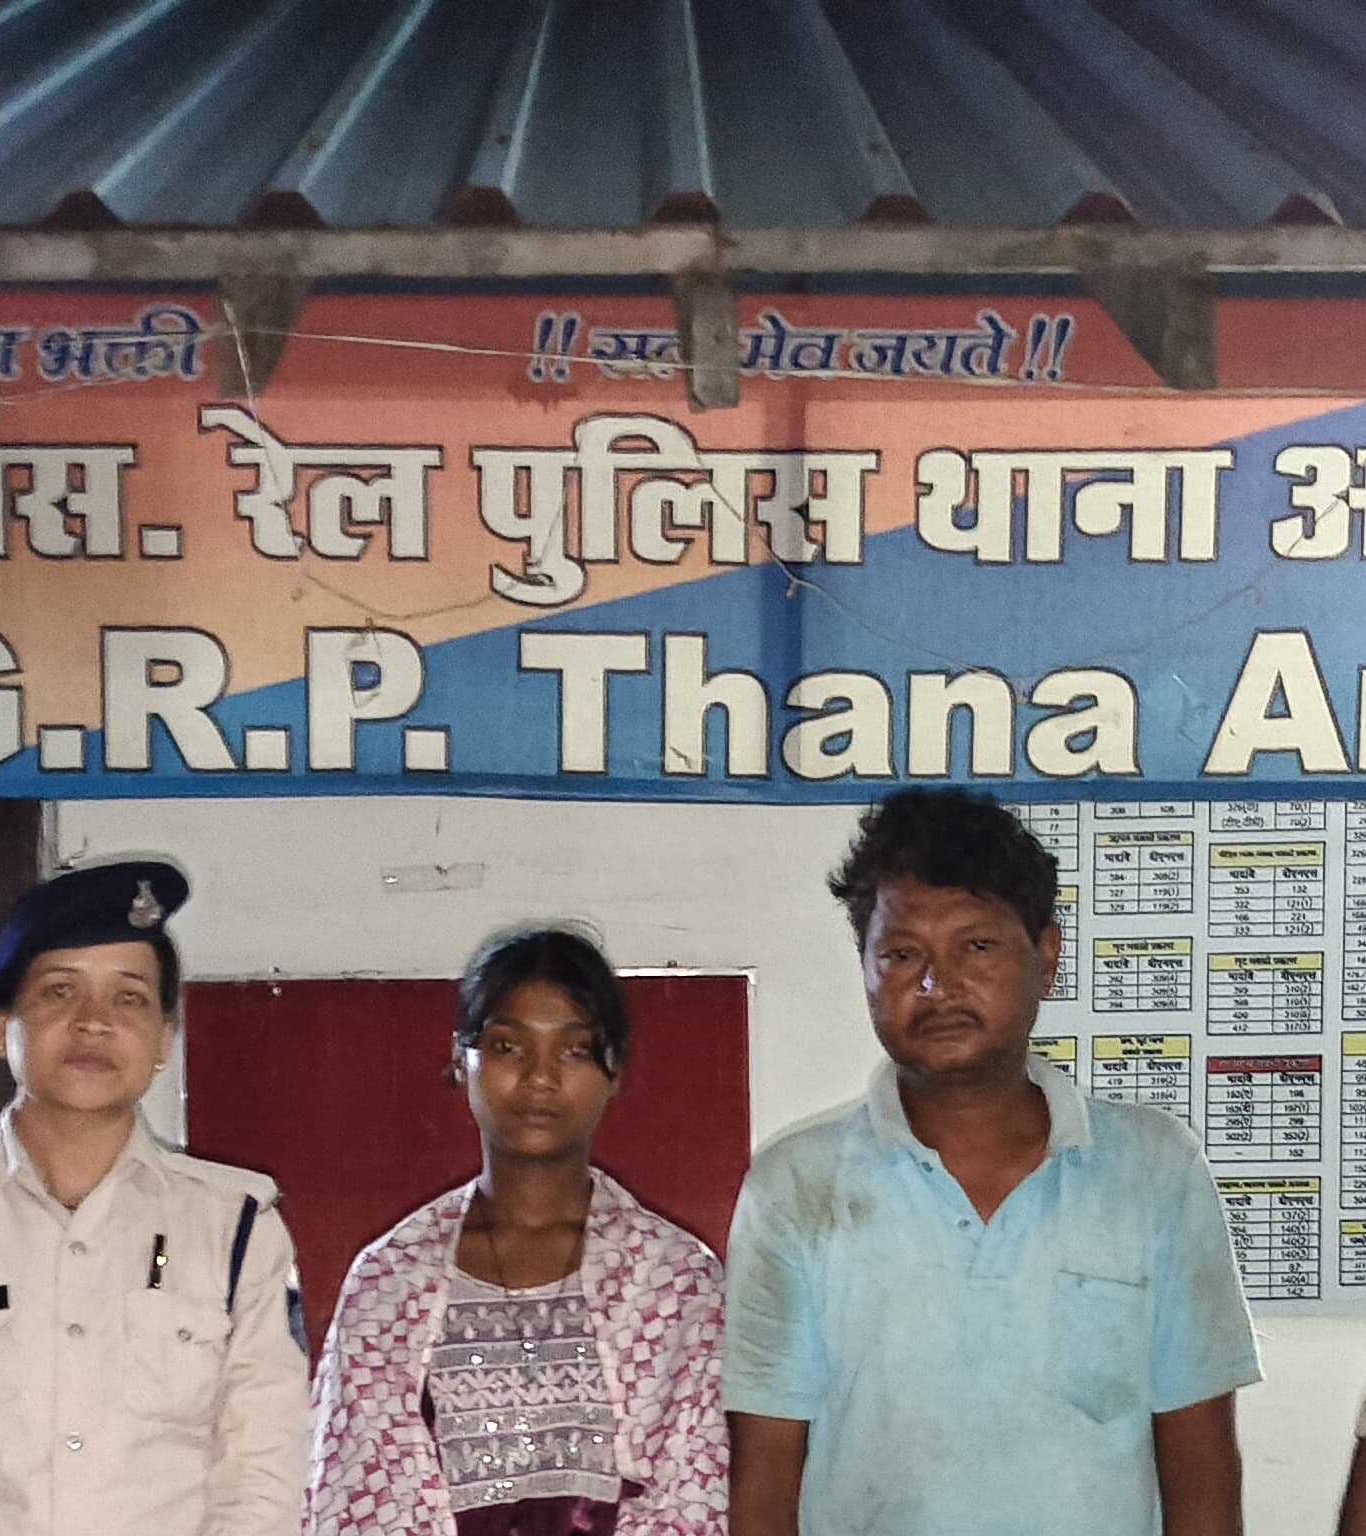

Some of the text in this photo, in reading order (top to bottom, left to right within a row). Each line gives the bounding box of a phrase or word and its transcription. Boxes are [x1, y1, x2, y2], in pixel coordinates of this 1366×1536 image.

[848, 307, 1018, 378] जयते
[197, 403, 443, 562] रेल
[471, 411, 882, 608] पुलिस
[913, 446, 1238, 565] थाना
[517, 629, 1143, 779] Thana
